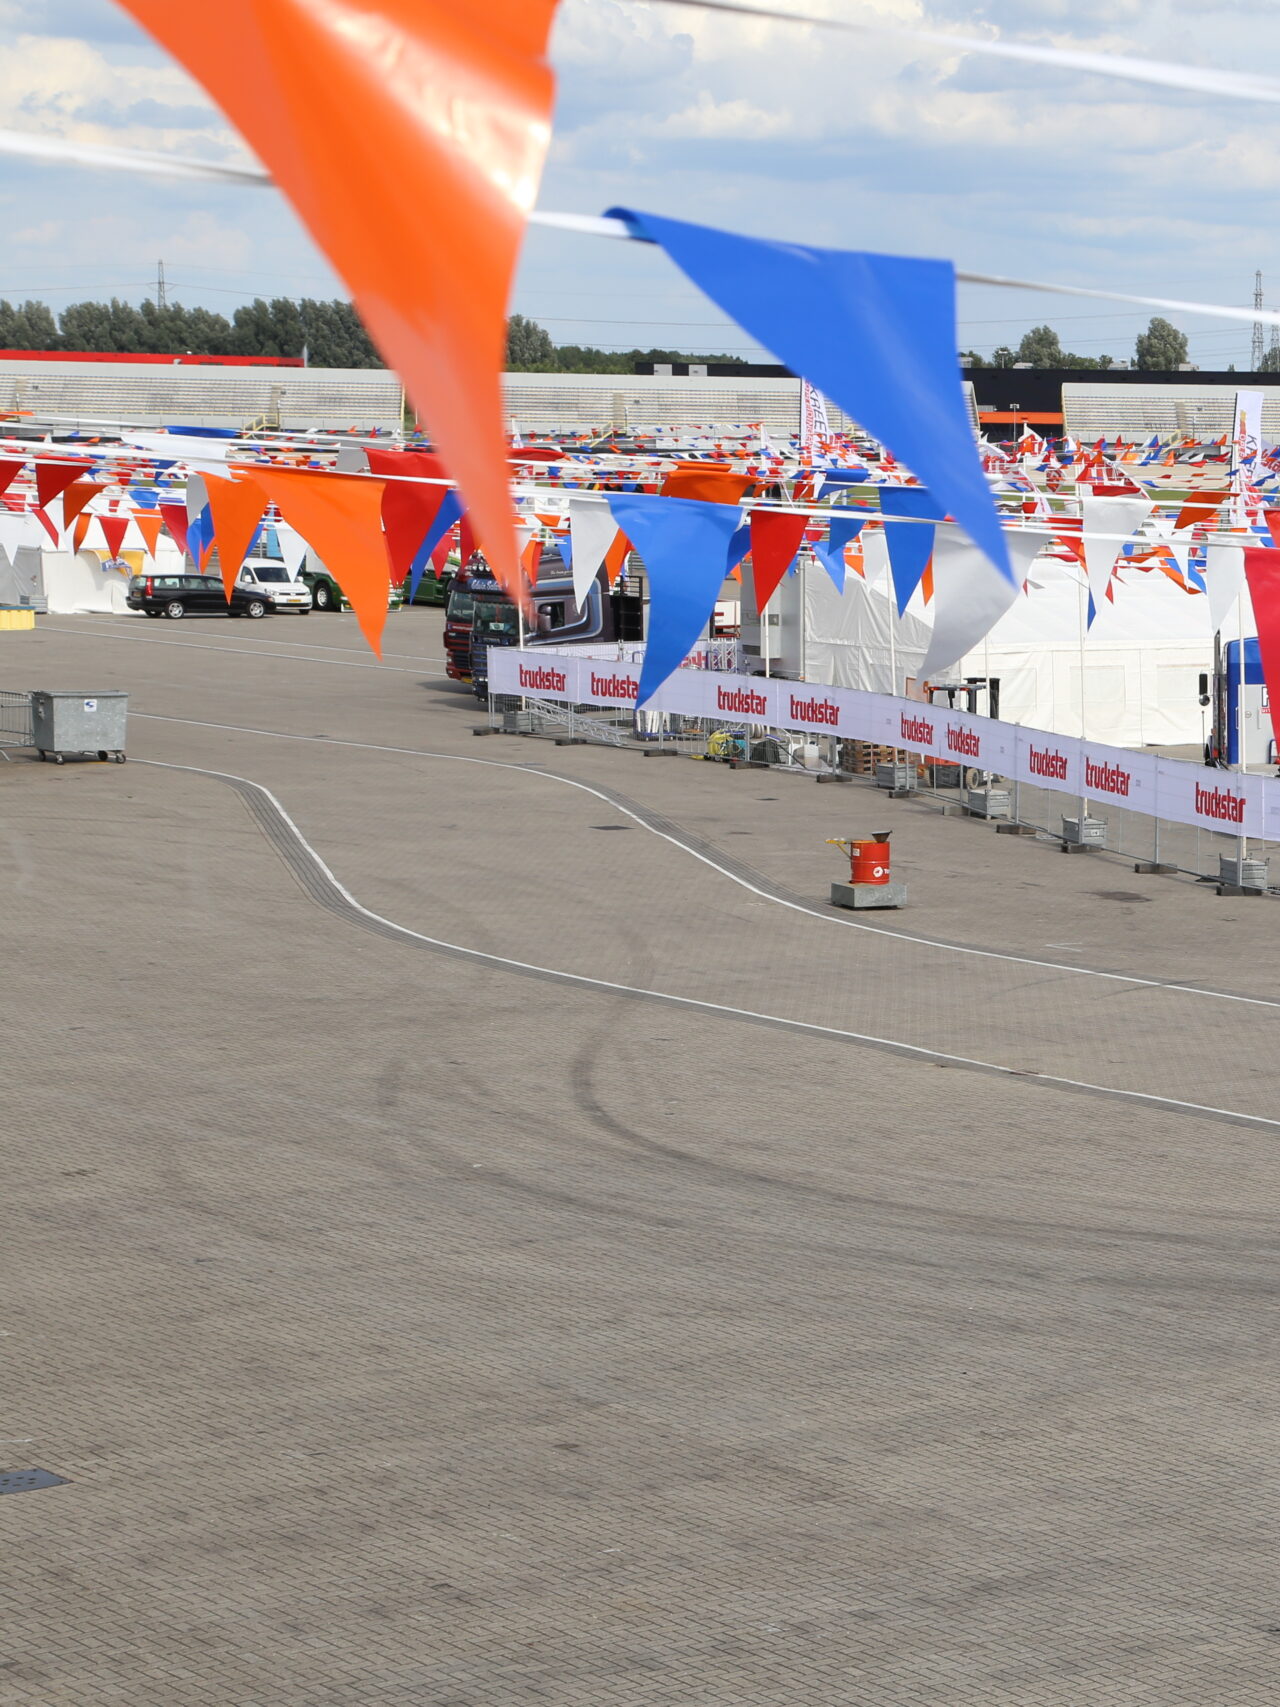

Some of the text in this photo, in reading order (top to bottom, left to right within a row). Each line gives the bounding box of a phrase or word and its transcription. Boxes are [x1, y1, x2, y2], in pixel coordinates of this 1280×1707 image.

[519, 663, 566, 692] truckstar
[591, 671, 639, 699] trucksta
[717, 685, 767, 716] truckstar
[790, 694, 840, 726] truckstar
[901, 711, 934, 746] truckstar
[947, 722, 980, 758] truckstar
[1029, 743, 1068, 781] truckstar
[1085, 756, 1131, 797] truckstar
[1195, 781, 1247, 824] truckstar
